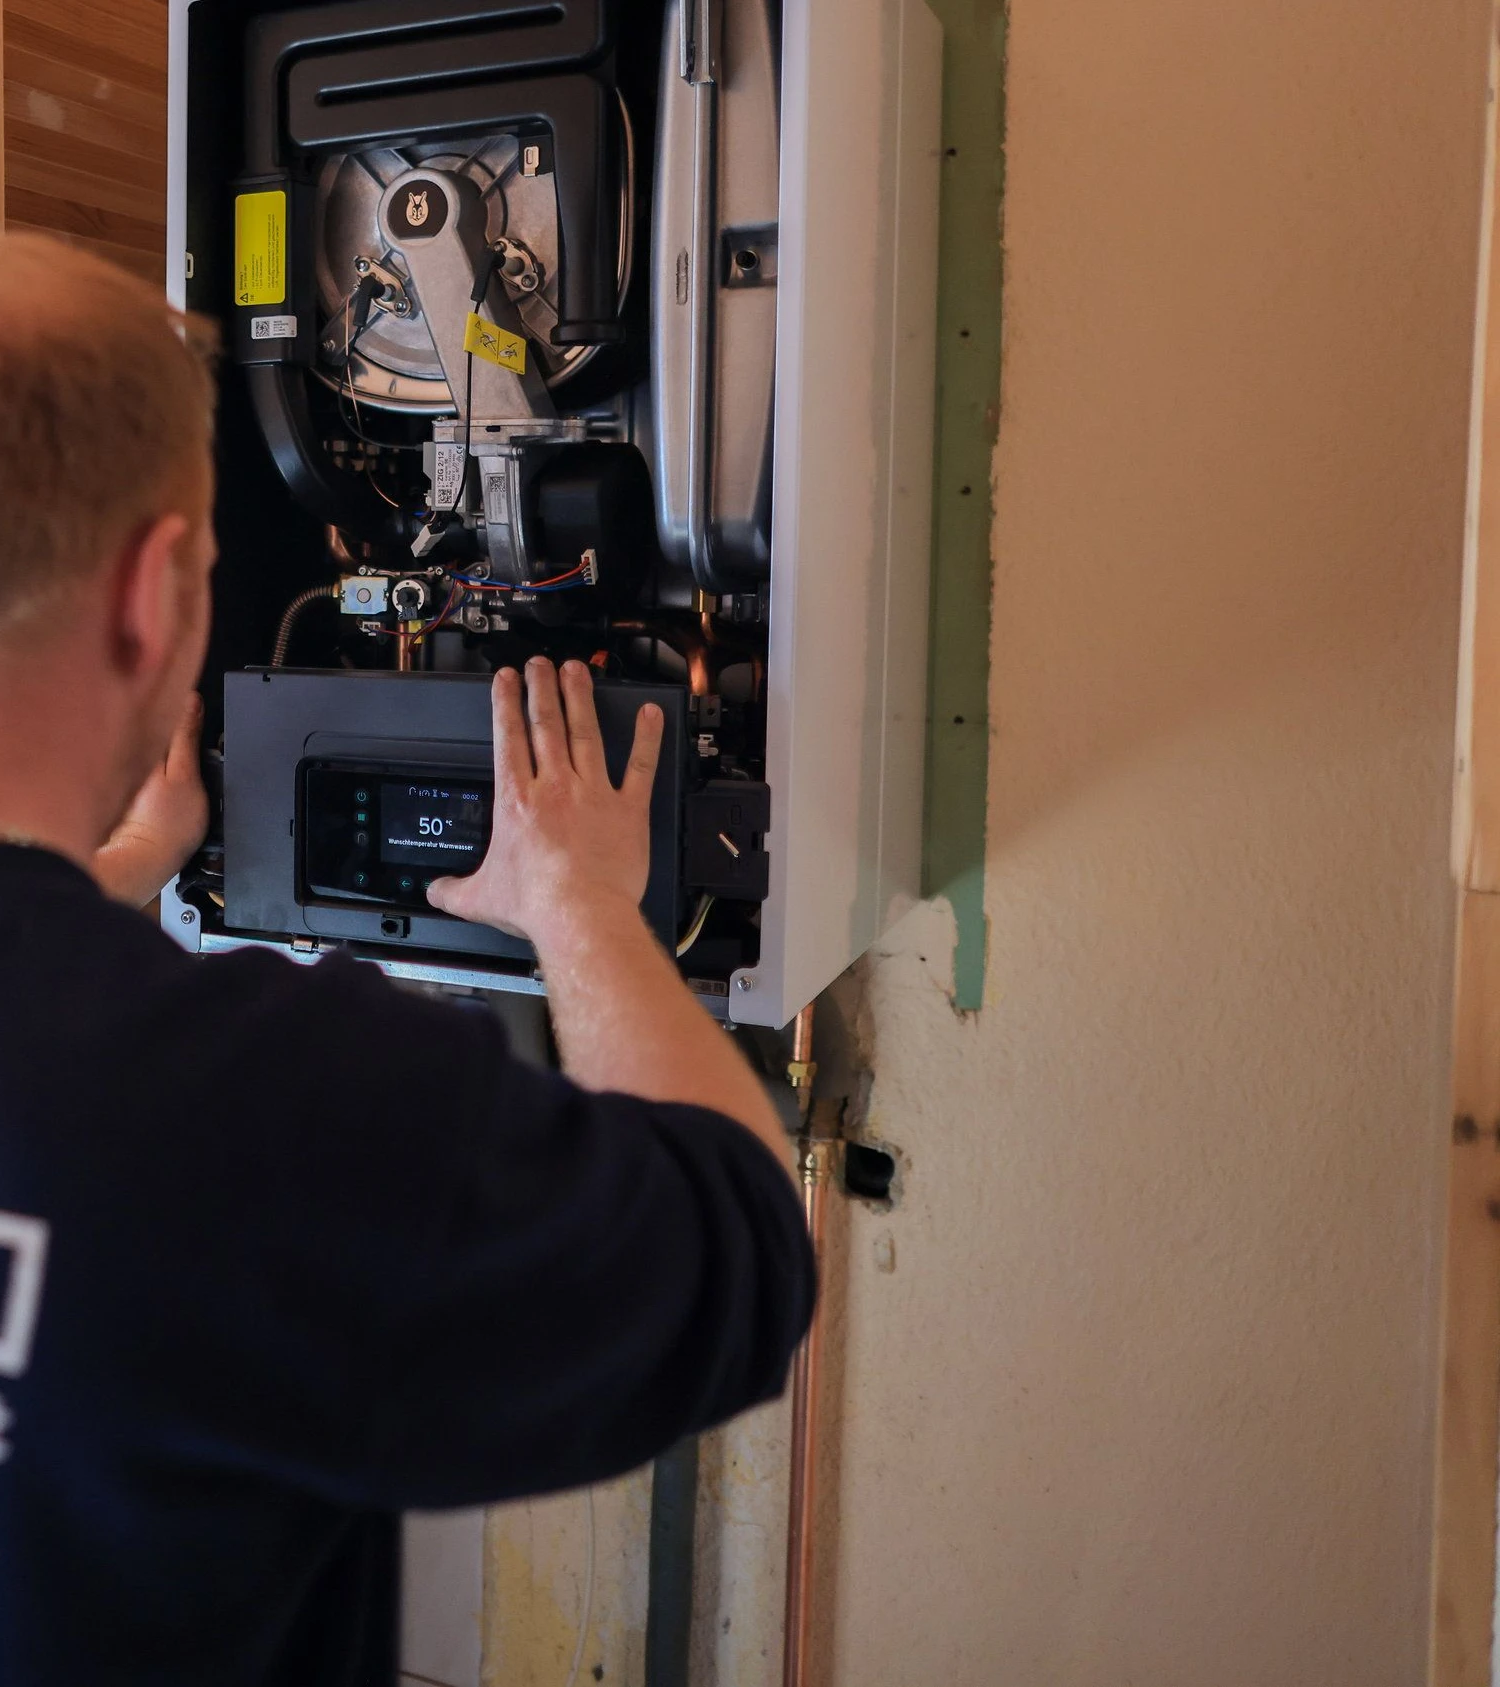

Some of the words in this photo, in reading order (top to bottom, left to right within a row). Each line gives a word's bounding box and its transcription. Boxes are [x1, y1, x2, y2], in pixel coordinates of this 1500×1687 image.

[419, 817, 443, 836] 50
[387, 838, 438, 848] Wunschtemperatur
[438, 842, 474, 851] Warmwasser
